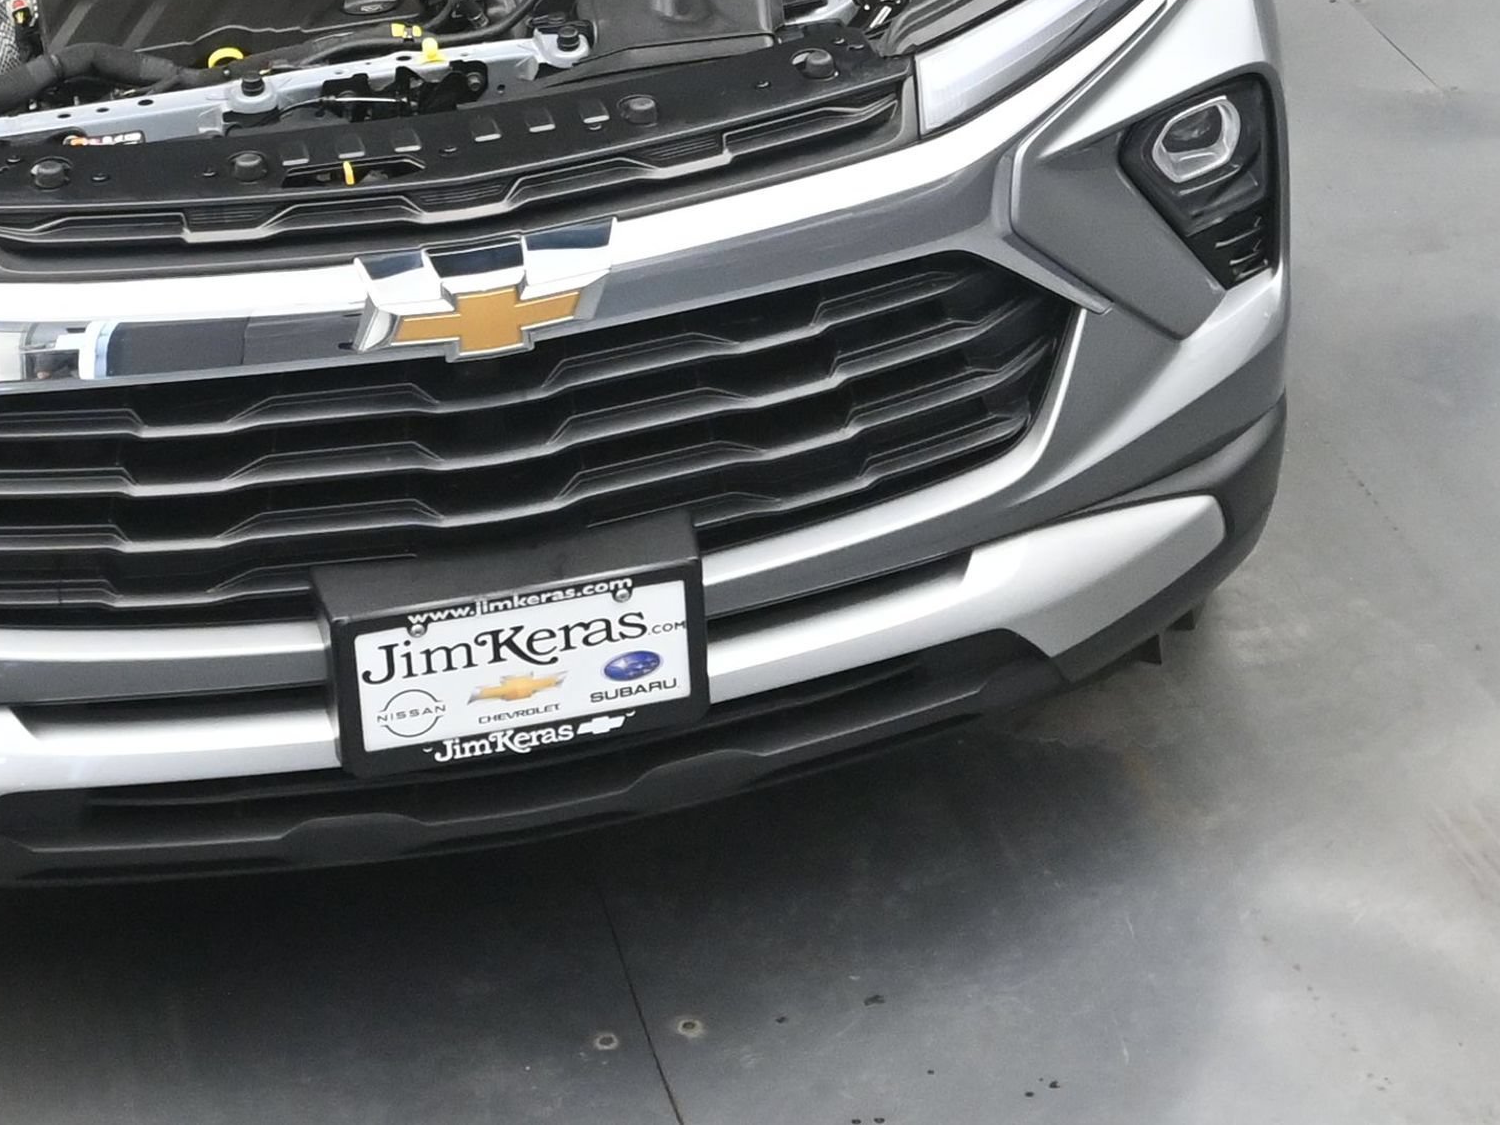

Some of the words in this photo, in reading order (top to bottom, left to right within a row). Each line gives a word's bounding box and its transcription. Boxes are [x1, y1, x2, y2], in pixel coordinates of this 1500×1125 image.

[408, 578, 632, 623] www.jimkeras.com
[590, 678, 677, 703] SUBARU
[377, 704, 446, 723] NISSAN
[478, 703, 560, 724] CHEVROLET
[434, 724, 575, 762] JimKeras
